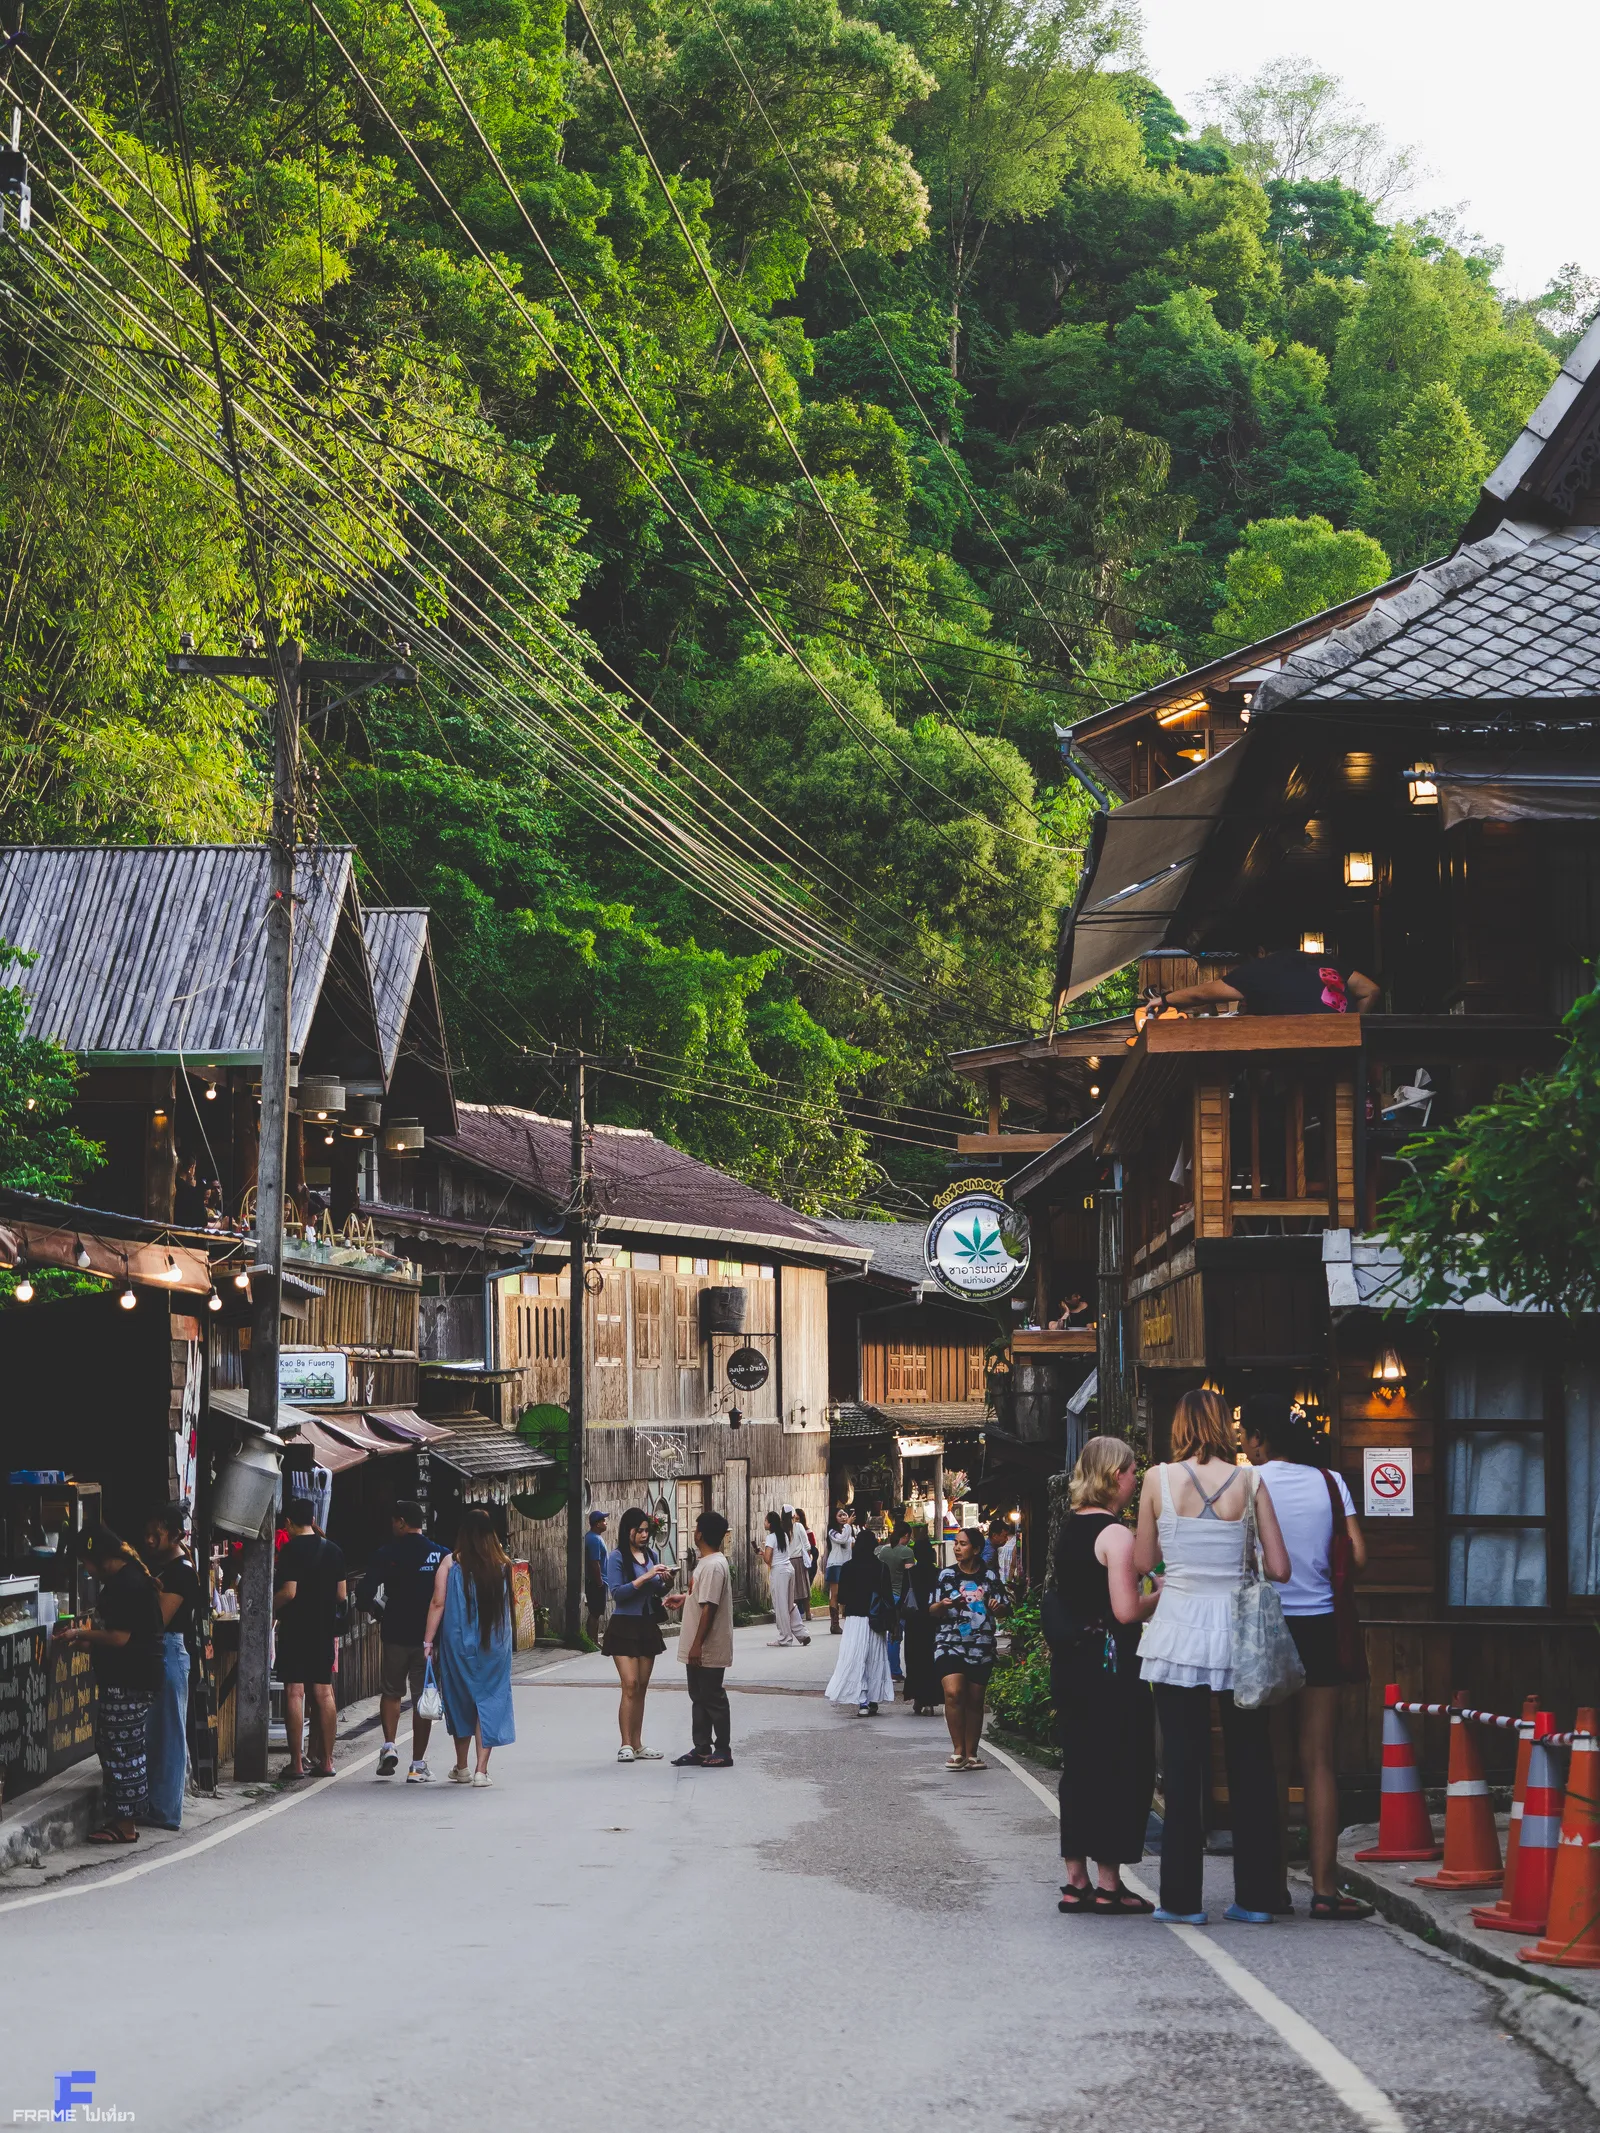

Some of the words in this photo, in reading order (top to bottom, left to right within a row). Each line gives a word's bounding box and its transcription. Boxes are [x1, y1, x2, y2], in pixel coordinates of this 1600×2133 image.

[949, 1262, 1008, 1275] ชาอารมณ์ดี
[962, 1275, 996, 1284] แม่กำปอง
[296, 1359, 305, 1367] Ba
[732, 1378, 747, 1390] Coffee
